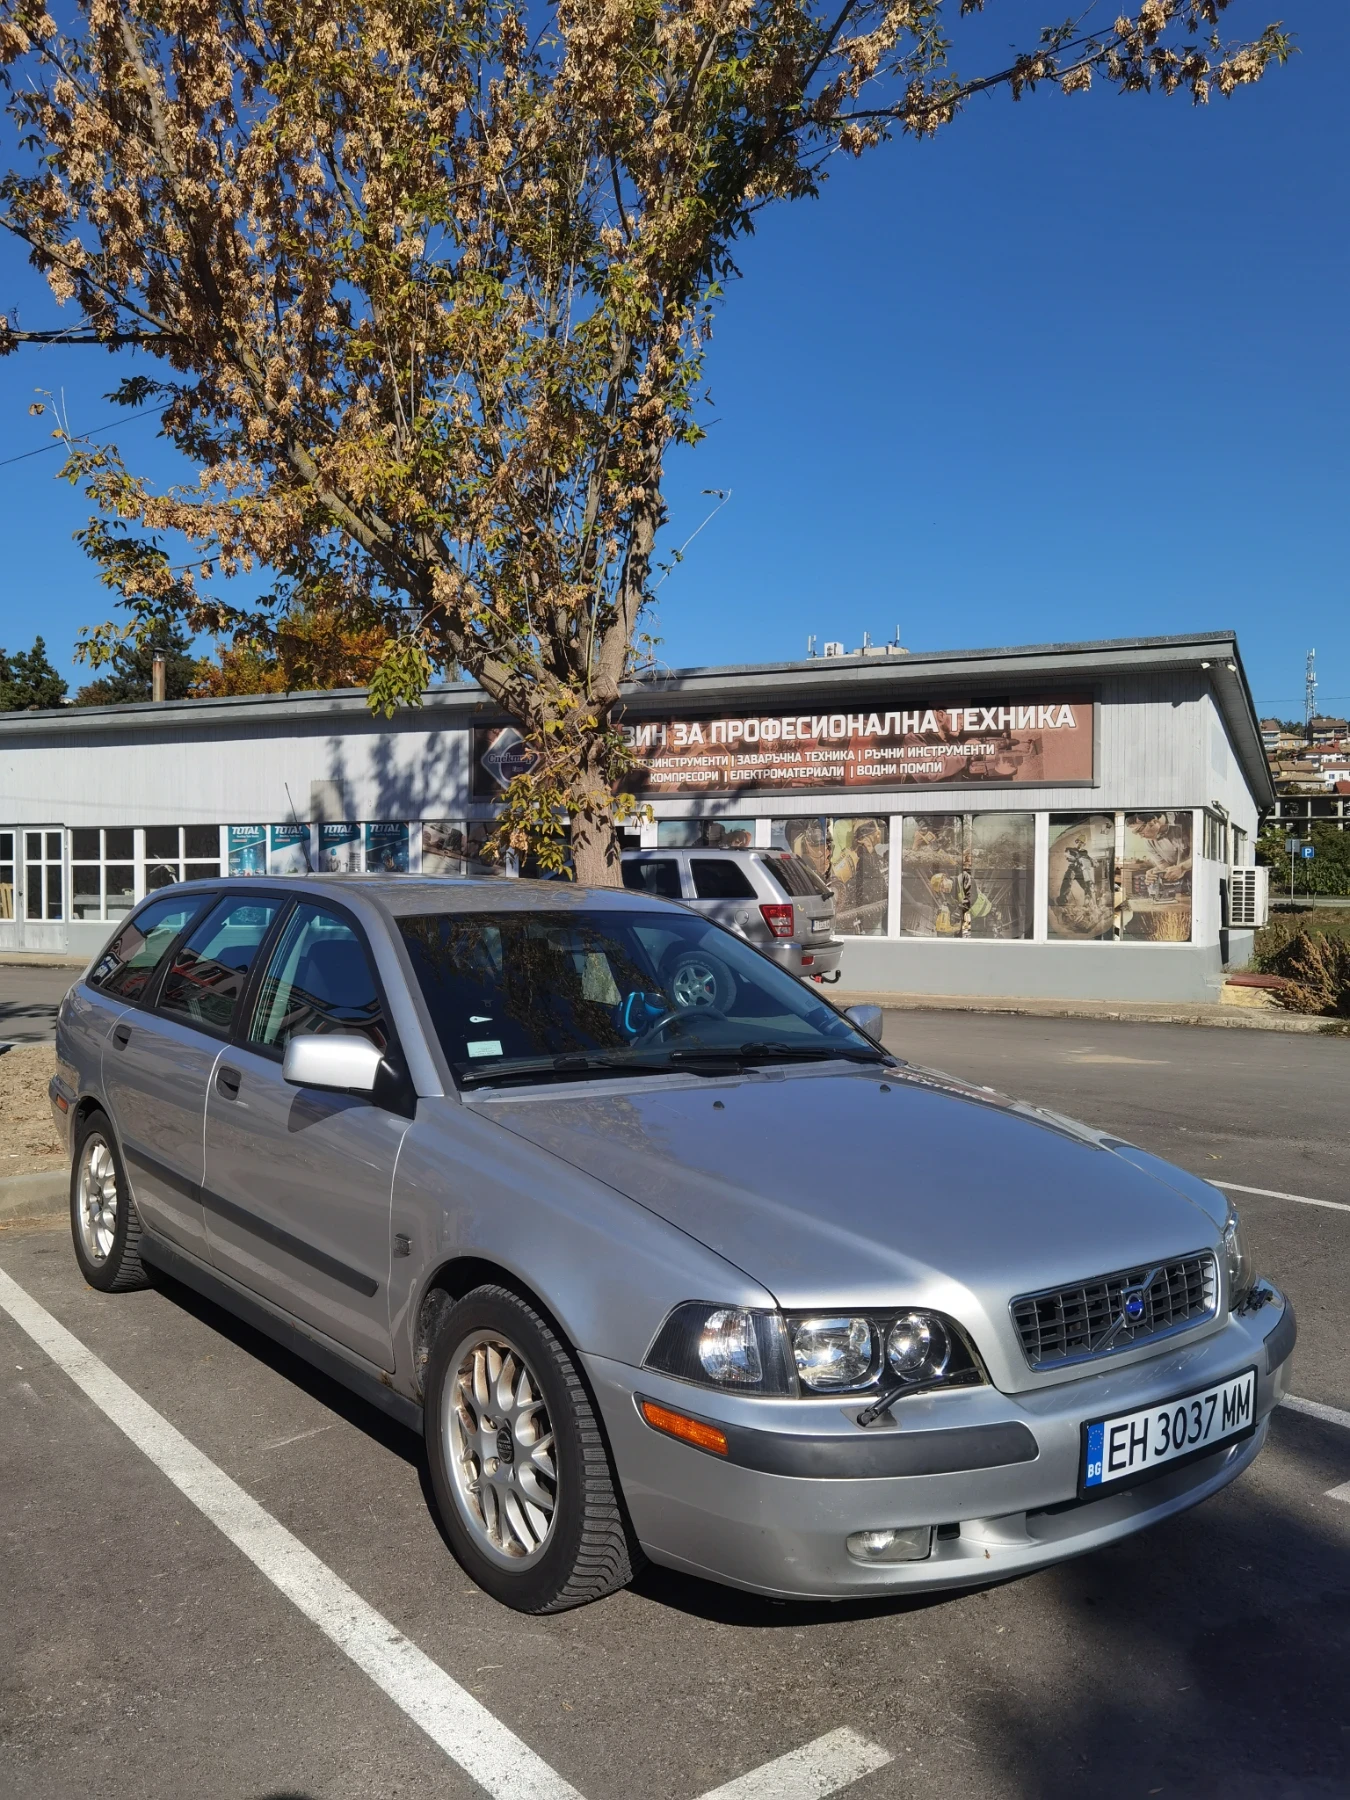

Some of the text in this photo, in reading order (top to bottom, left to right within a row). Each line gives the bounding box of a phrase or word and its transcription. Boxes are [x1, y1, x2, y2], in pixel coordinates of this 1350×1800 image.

[673, 722, 704, 746] ЗА
[711, 711, 939, 744] ПРОФЕСИОНАЛНА
[948, 703, 1076, 732] ТЕХНИКА
[488, 753, 535, 764] Спектр
[737, 751, 802, 765] ЗАВАРЪЧНА
[804, 750, 855, 762] ТЕХНИКА
[864, 747, 904, 760] РЪЧНИ
[907, 743, 995, 758] ИНСТРУМЕНТИ
[650, 761, 943, 783] КОМПРЕСОРИ ЕЛЕКТРОМАТЕРИАЛИ ВОДНИ ПОМПИ
[232, 826, 260, 835] TOTAL
[274, 826, 303, 835] TOTAL
[323, 824, 353, 834] TOTAL
[369, 823, 401, 833] TOTAL
[1304, 848, 1312, 858] P
[1108, 1378, 1251, 1473] EH 3037 MM
[1087, 1462, 1102, 1478] BG
